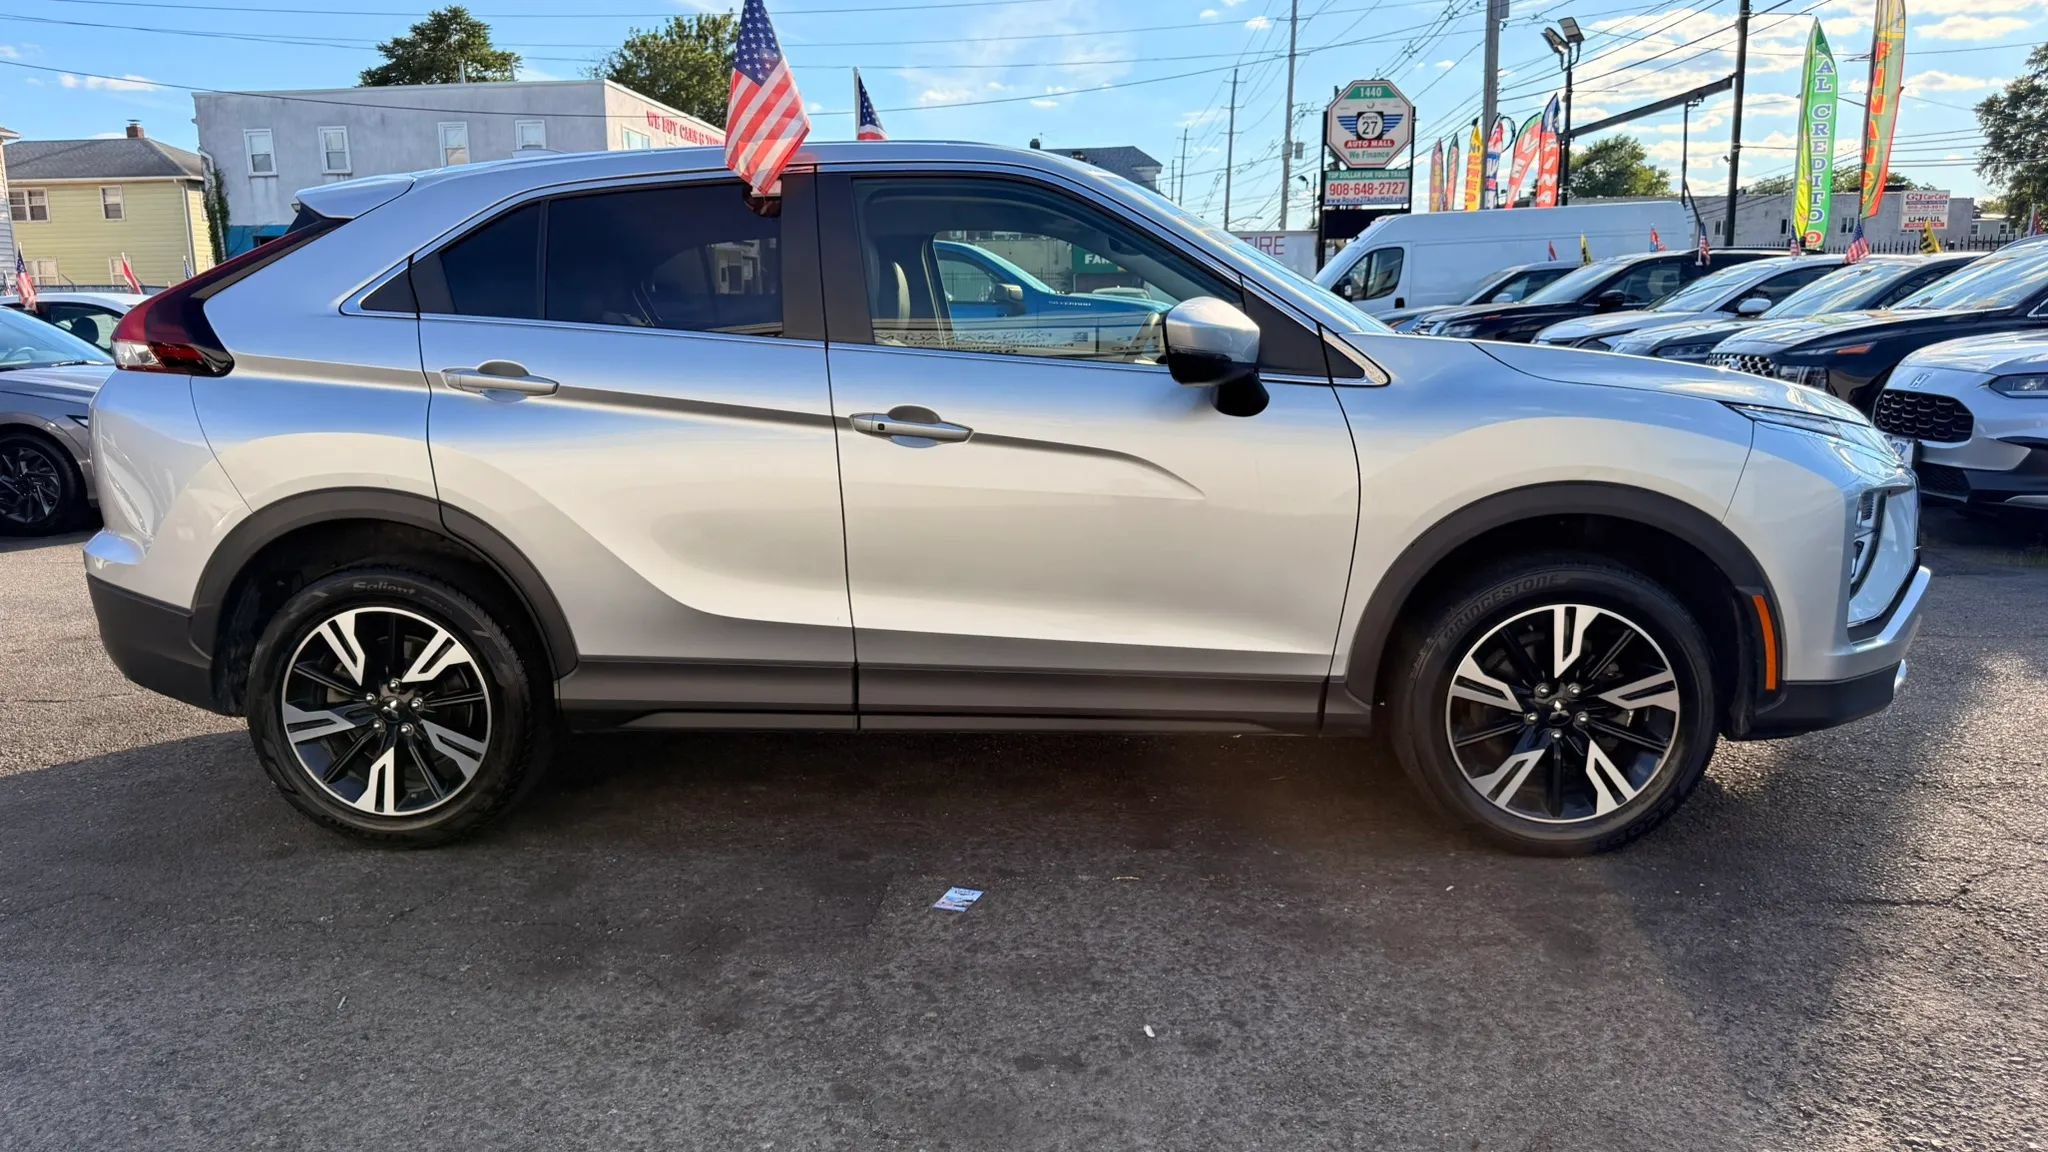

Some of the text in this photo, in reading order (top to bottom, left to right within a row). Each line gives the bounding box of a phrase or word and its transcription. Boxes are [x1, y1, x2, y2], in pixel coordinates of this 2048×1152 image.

[1360, 87, 1382, 97] 1440
[646, 110, 660, 129] WE
[1361, 121, 1378, 135] 27
[1346, 139, 1393, 148] AUTO MALL
[1349, 150, 1390, 159] We Finance
[1808, 104, 1832, 223] CREDITO
[1329, 182, 1406, 196] 908-648-2727
[1241, 235, 1285, 256] TIRE
